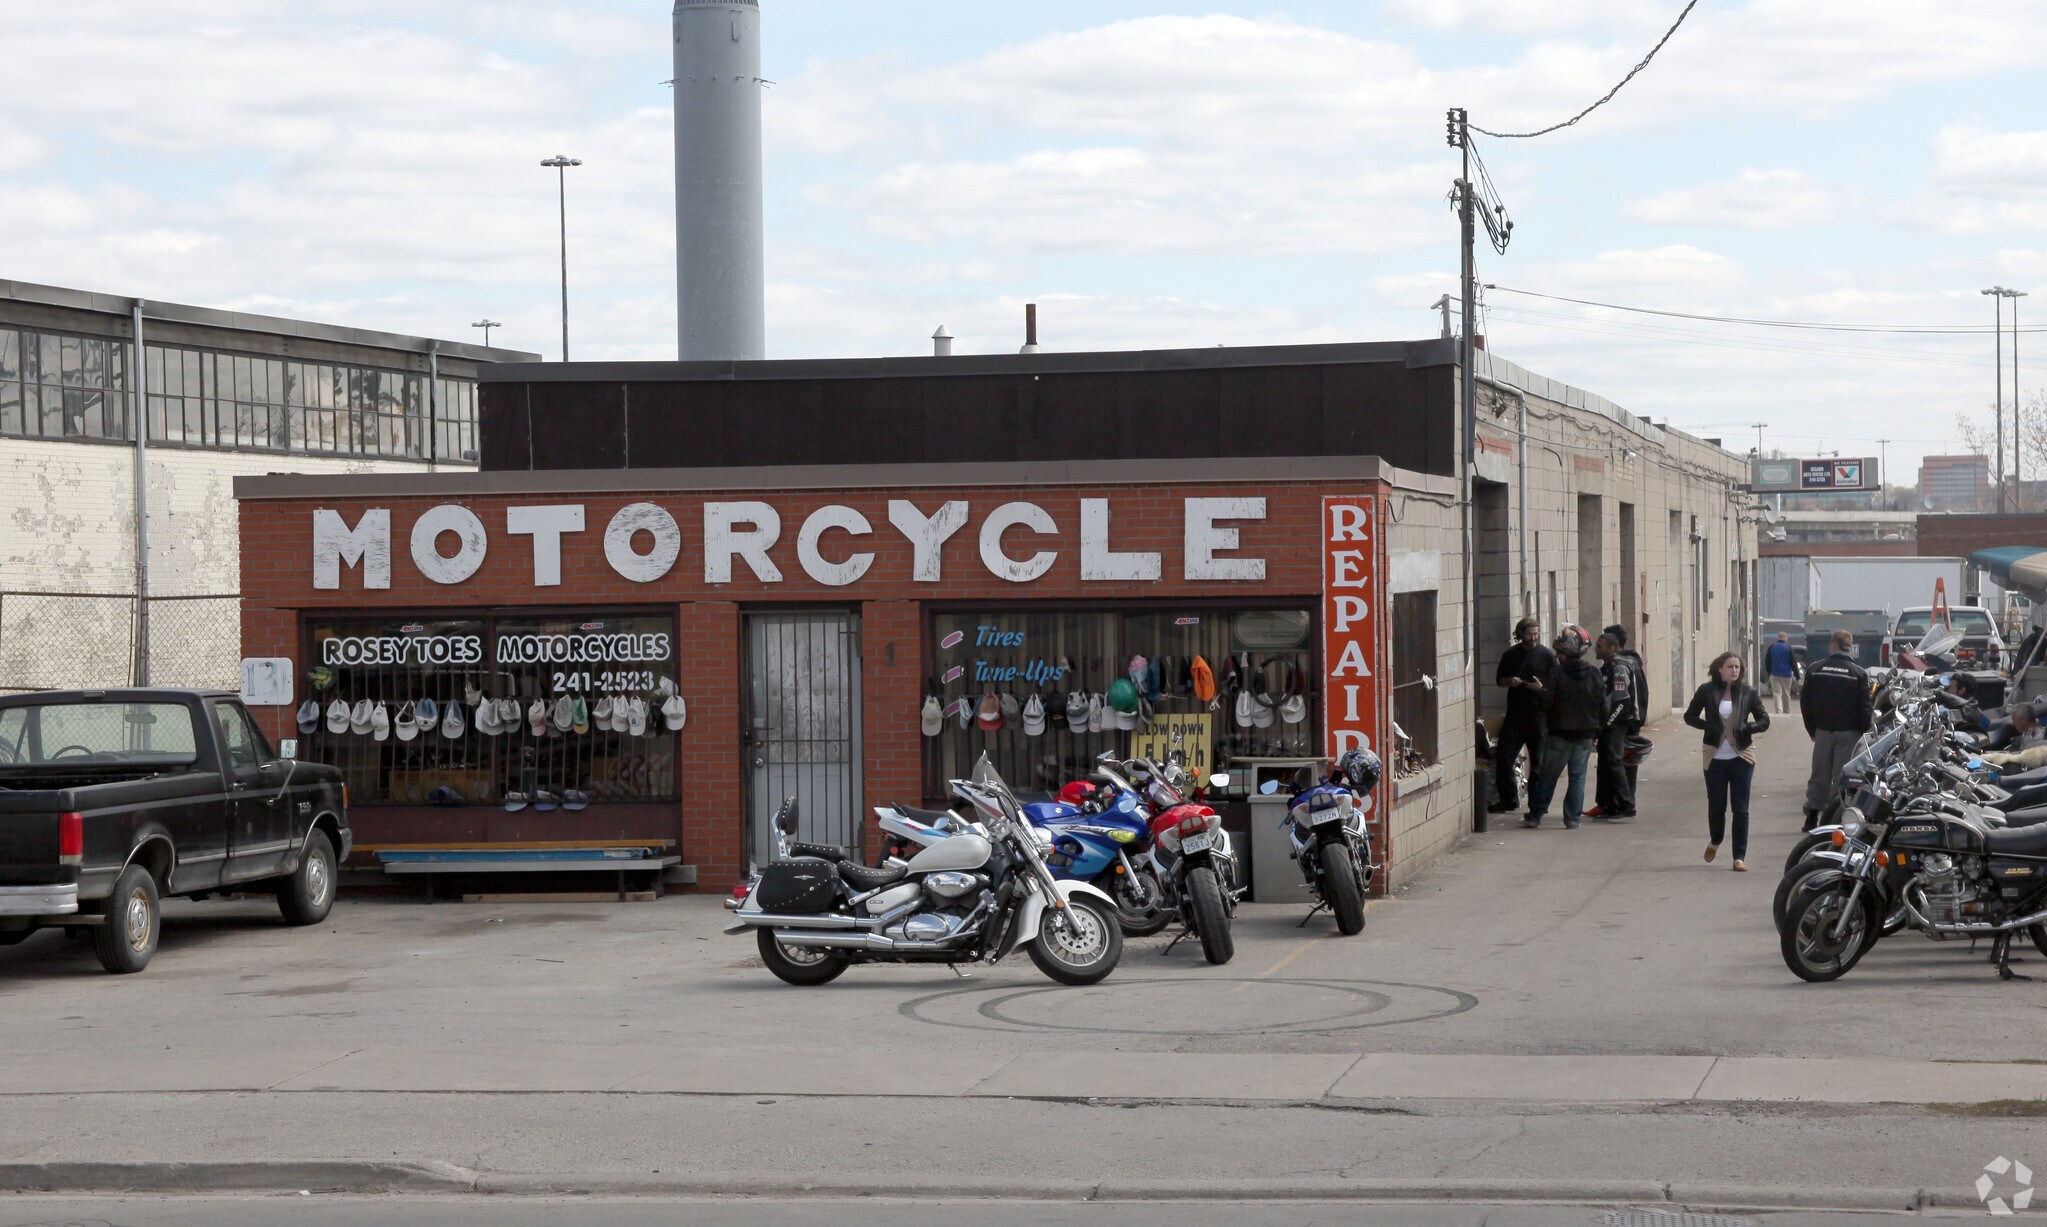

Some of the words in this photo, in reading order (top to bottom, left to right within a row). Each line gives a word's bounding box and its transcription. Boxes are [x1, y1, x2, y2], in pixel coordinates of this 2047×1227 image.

[313, 496, 1267, 590] MOTORCYCLE
[323, 636, 411, 665] ROSEY
[413, 635, 482, 664] TOES
[497, 633, 670, 663] MOTORCYCLES
[975, 625, 1025, 647] Tires
[553, 670, 655, 692] 241-2523
[975, 659, 1063, 687] Tune-Ups
[1140, 723, 1168, 736] LOW
